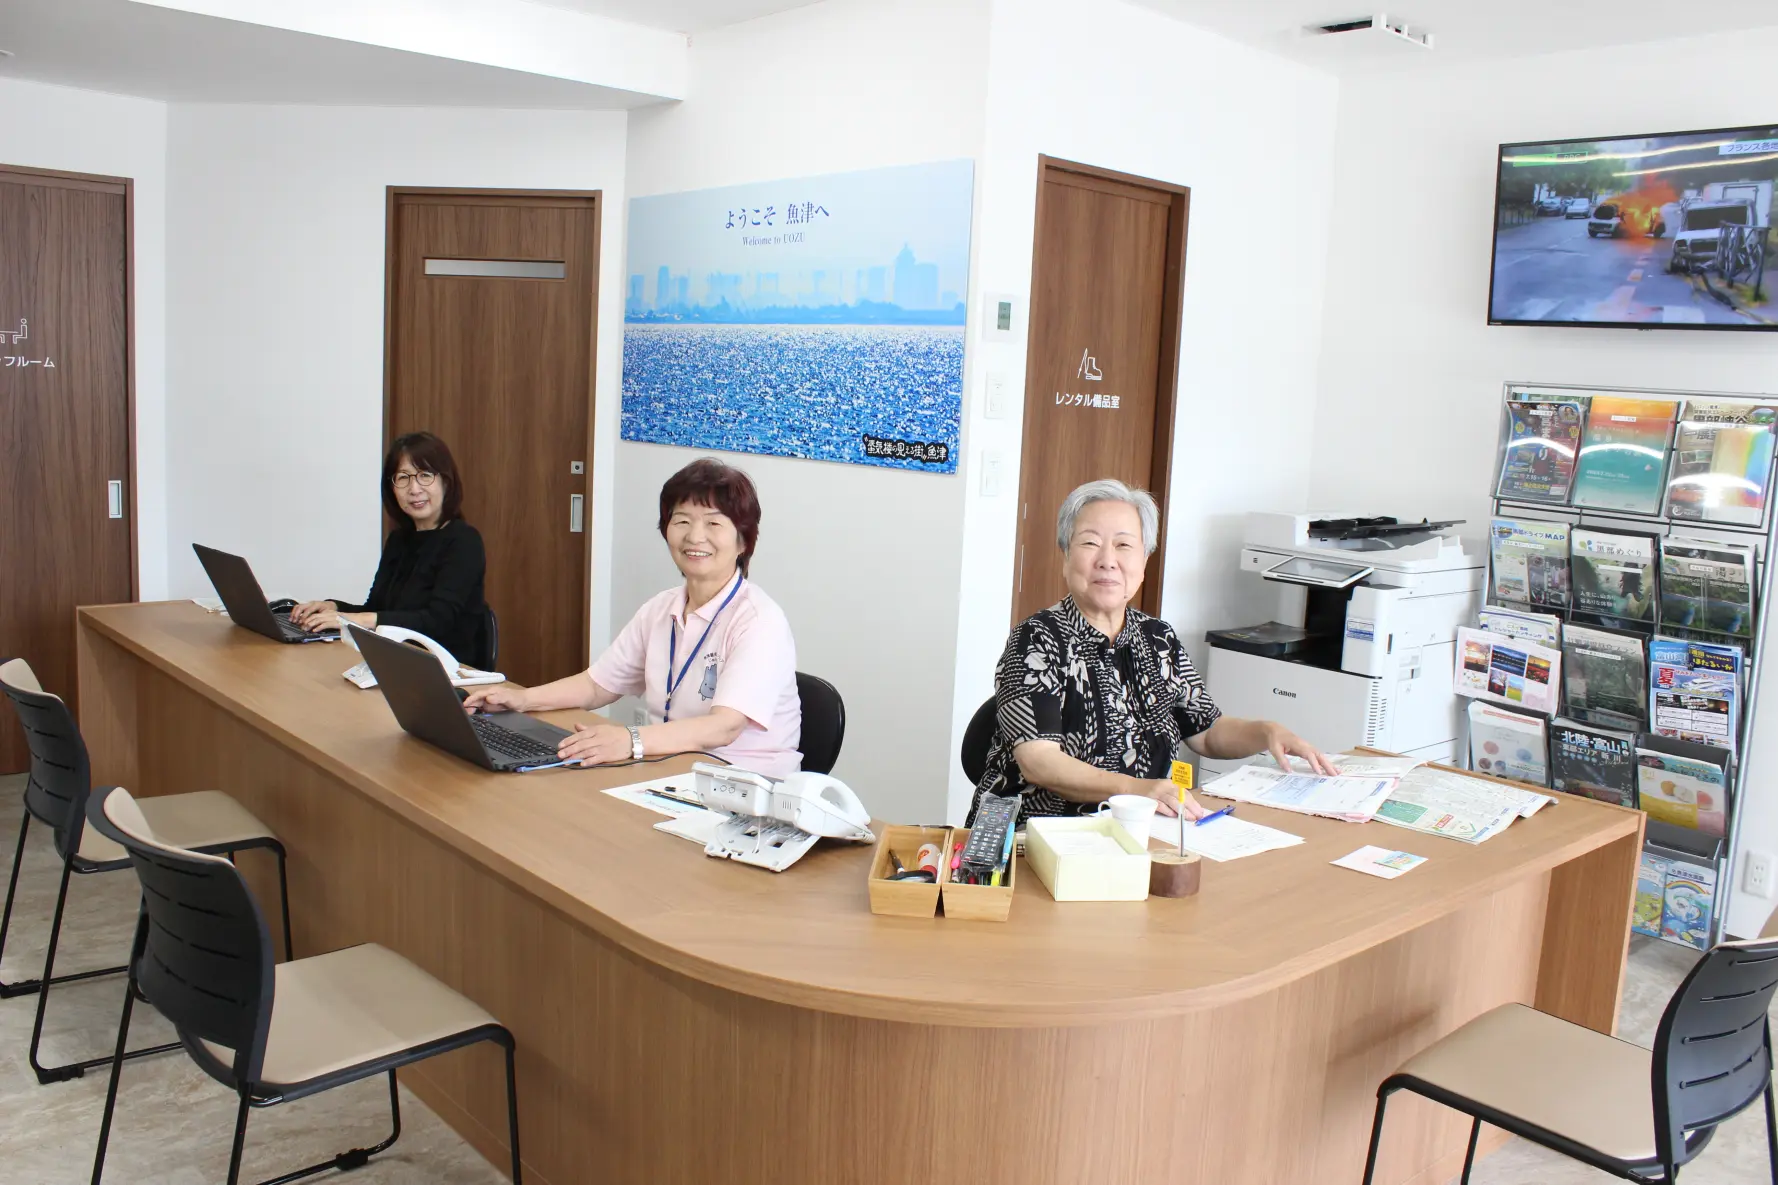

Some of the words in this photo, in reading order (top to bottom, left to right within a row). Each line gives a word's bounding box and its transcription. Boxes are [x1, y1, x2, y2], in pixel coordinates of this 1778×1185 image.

[725, 206, 777, 230] ようこそ
[785, 201, 830, 225] 魚津へ
[742, 236, 772, 246] Welcome
[774, 235, 781, 244] to
[783, 232, 805, 244] UOZU
[0, 355, 55, 368] フルーム
[1055, 391, 1120, 409] レンタル備品室
[1657, 667, 1676, 685] 夏
[1272, 687, 1297, 699] Canon
